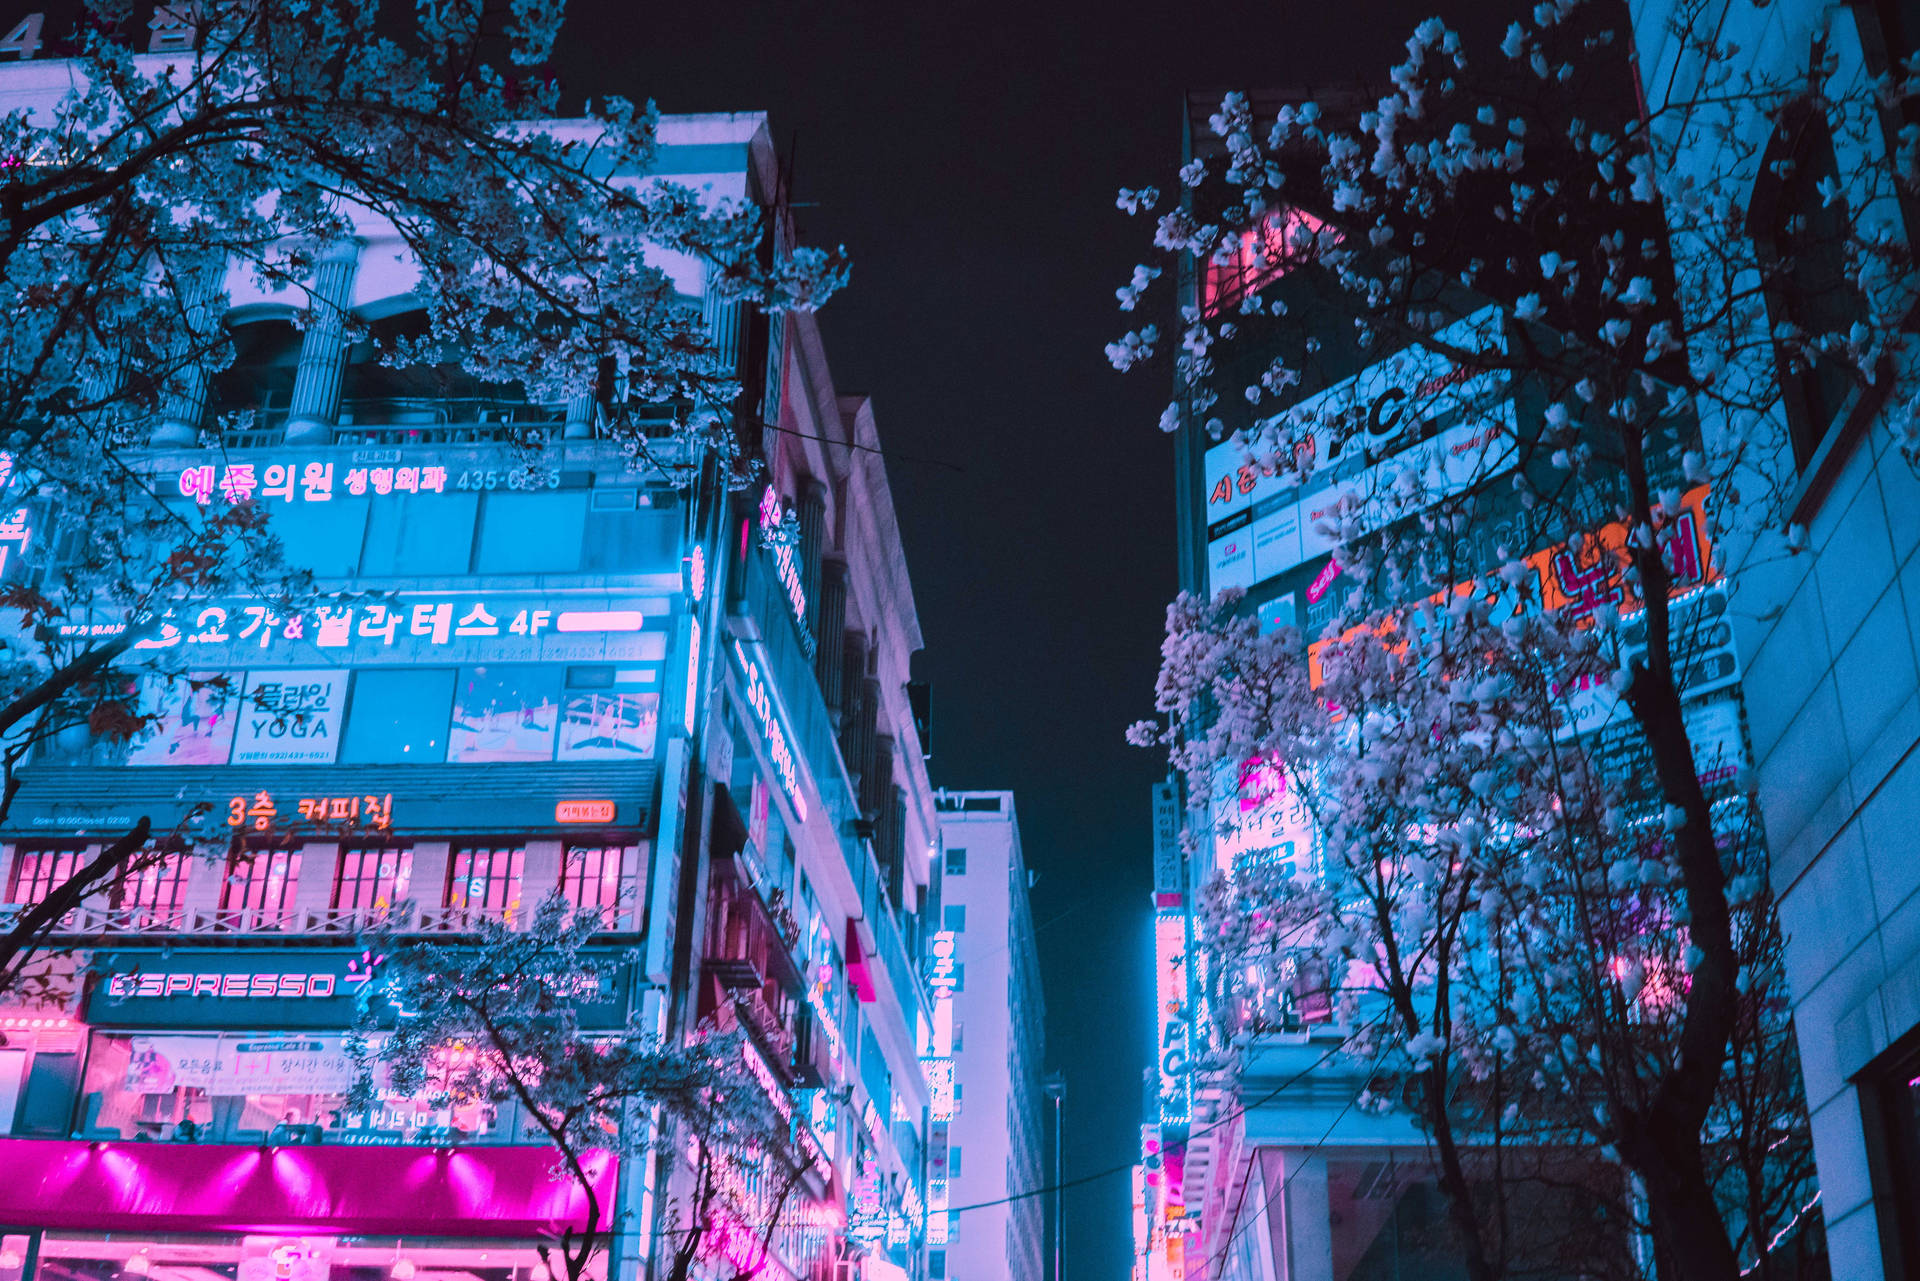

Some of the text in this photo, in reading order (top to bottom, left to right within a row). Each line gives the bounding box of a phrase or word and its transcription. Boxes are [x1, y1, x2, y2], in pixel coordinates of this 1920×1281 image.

[343, 466, 448, 495] 성형외과
[509, 610, 551, 636] 4F
[251, 719, 328, 738] YOGA
[227, 790, 277, 831] 3층
[108, 973, 336, 997] ESPRESSO
